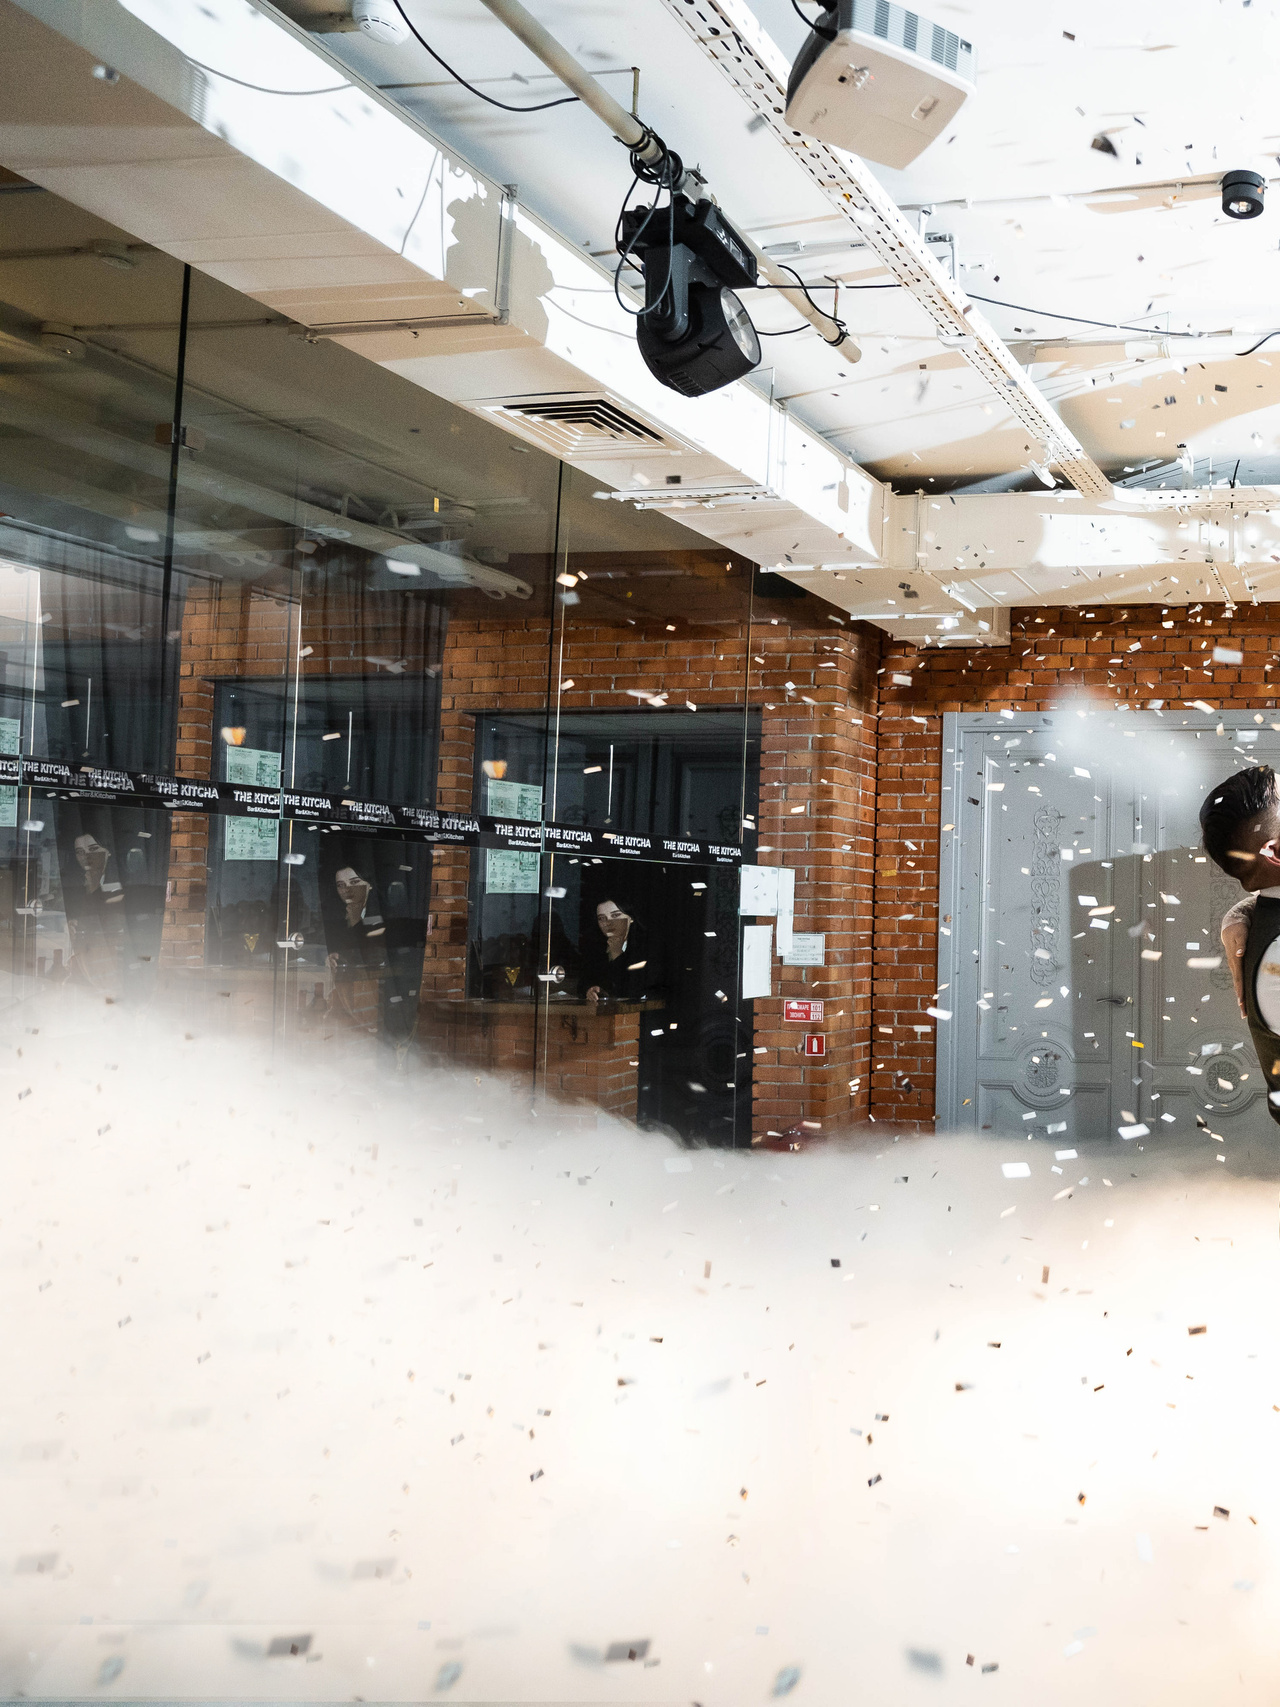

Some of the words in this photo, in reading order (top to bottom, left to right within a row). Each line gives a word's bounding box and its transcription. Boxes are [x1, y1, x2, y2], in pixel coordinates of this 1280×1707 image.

[22, 761, 39, 772] THE
[40, 763, 70, 776] KITCHA
[157, 781, 178, 796] THE
[181, 784, 219, 799] KITCHA
[233, 790, 252, 803] THE
[254, 792, 280, 806] KITCH
[283, 794, 300, 806] THE
[301, 796, 331, 809] KITCHA
[441, 818, 480, 833] KITCHA
[494, 823, 513, 836] THE
[515, 825, 541, 839] KITCH
[544, 827, 561, 840] THE
[562, 829, 593, 843] KITCHA
[610, 835, 624, 846] THE
[625, 836, 651, 849] KITCHA
[663, 840, 677, 851] THE
[677, 841, 700, 853] KITCHA
[708, 845, 720, 855] THE
[721, 846, 742, 857] KITCHA
